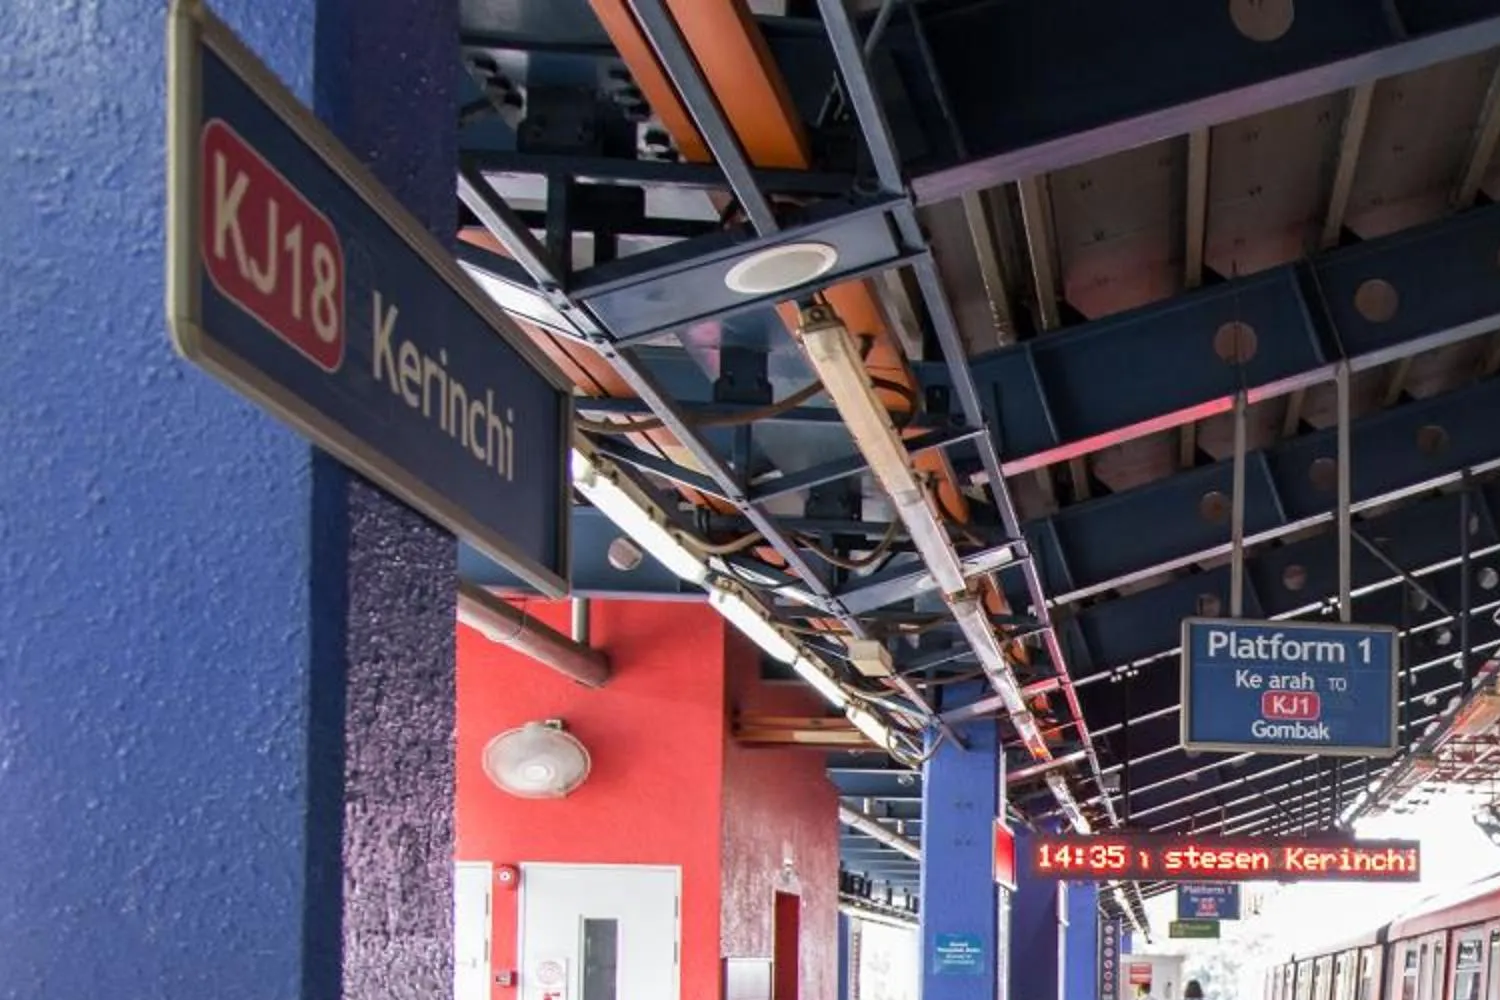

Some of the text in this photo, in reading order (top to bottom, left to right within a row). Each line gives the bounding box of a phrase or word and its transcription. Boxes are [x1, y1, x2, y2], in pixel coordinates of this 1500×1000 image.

[214, 149, 515, 483] KJ18 Kerinchi
[1207, 630, 1372, 664] Platform 1
[1235, 669, 1348, 692] Ke arah TO
[1272, 694, 1311, 716] KJ1
[1251, 719, 1331, 740] Gombak
[1038, 845, 1126, 868] 14:35
[1164, 845, 1270, 871] stesen
[1285, 847, 1417, 872] Kerinchi
